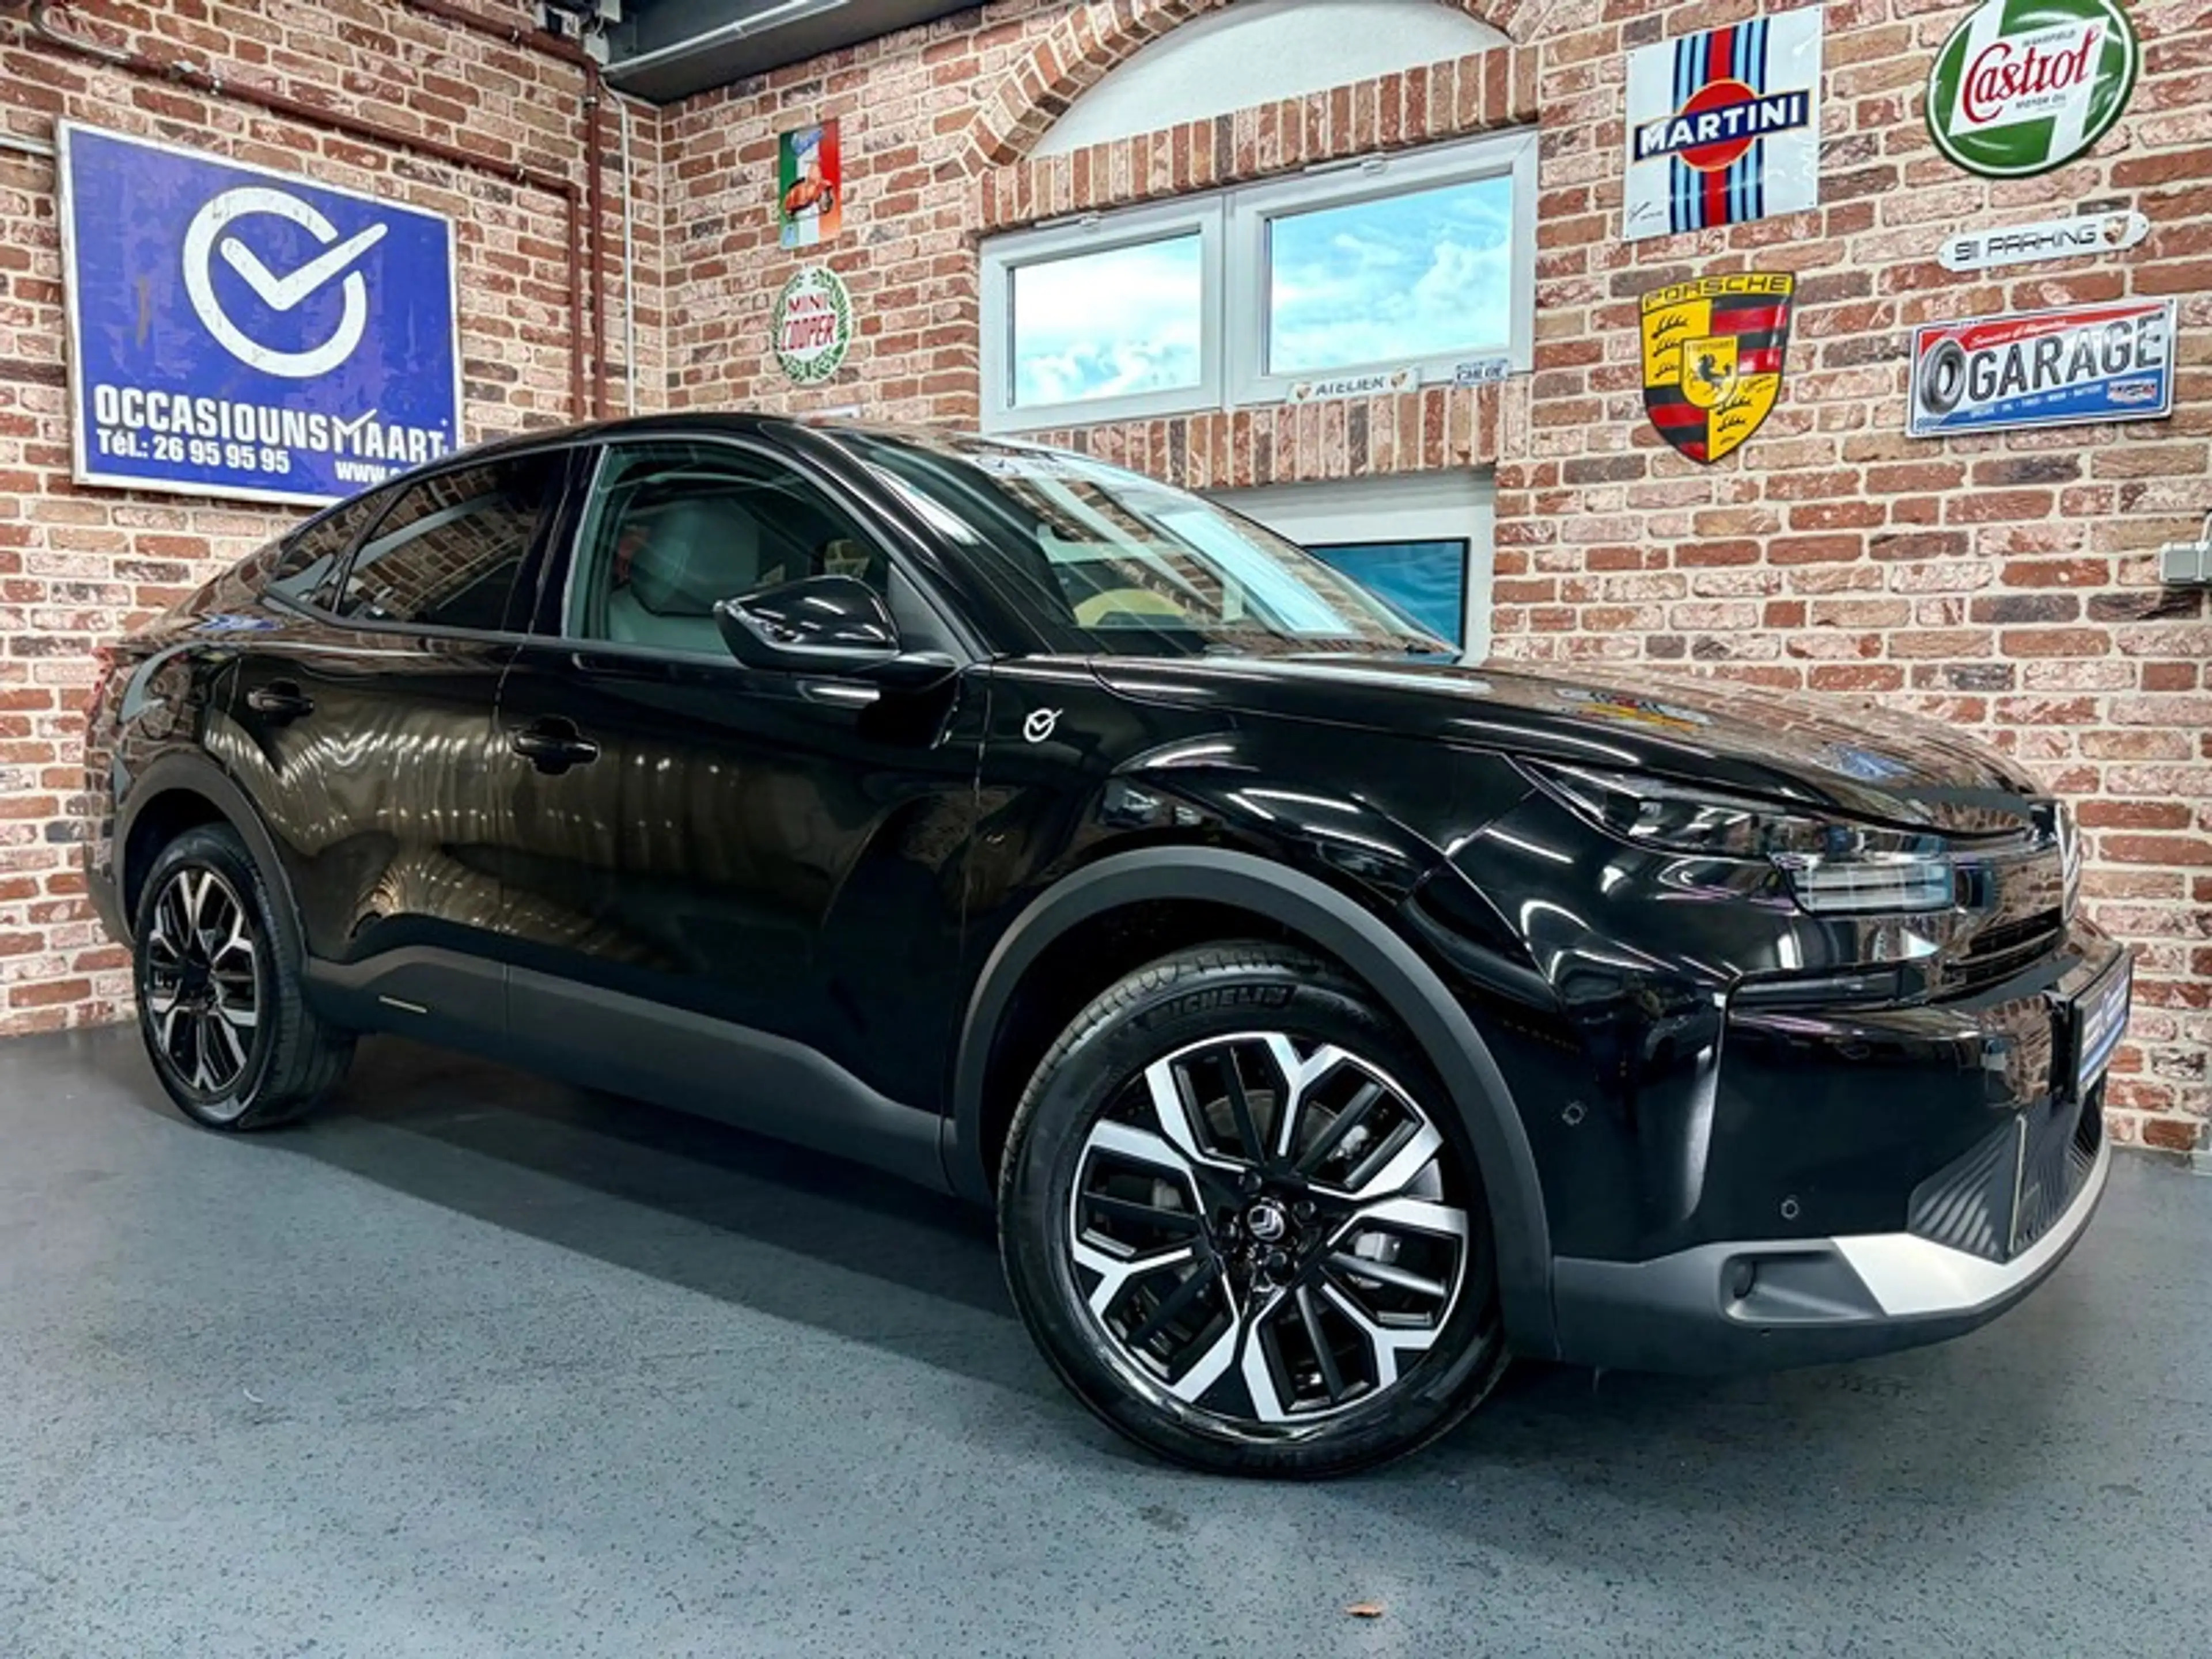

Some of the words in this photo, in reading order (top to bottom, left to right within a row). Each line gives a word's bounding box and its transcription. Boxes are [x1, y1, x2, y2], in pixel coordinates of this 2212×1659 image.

[1963, 24, 2101, 123] Castrol
[1640, 96, 1801, 155] MARTINI
[1988, 224, 2097, 257] PARKING
[787, 291, 828, 315] MINI
[1643, 275, 1787, 310] PORSCHE
[780, 313, 836, 351] COOPER
[1968, 311, 2165, 402] GARAGE
[94, 383, 444, 463] OCCASIOUNSMAART
[152, 434, 184, 462] 26
[189, 439, 221, 466] 95
[226, 442, 256, 471] 95
[260, 447, 291, 474] 95
